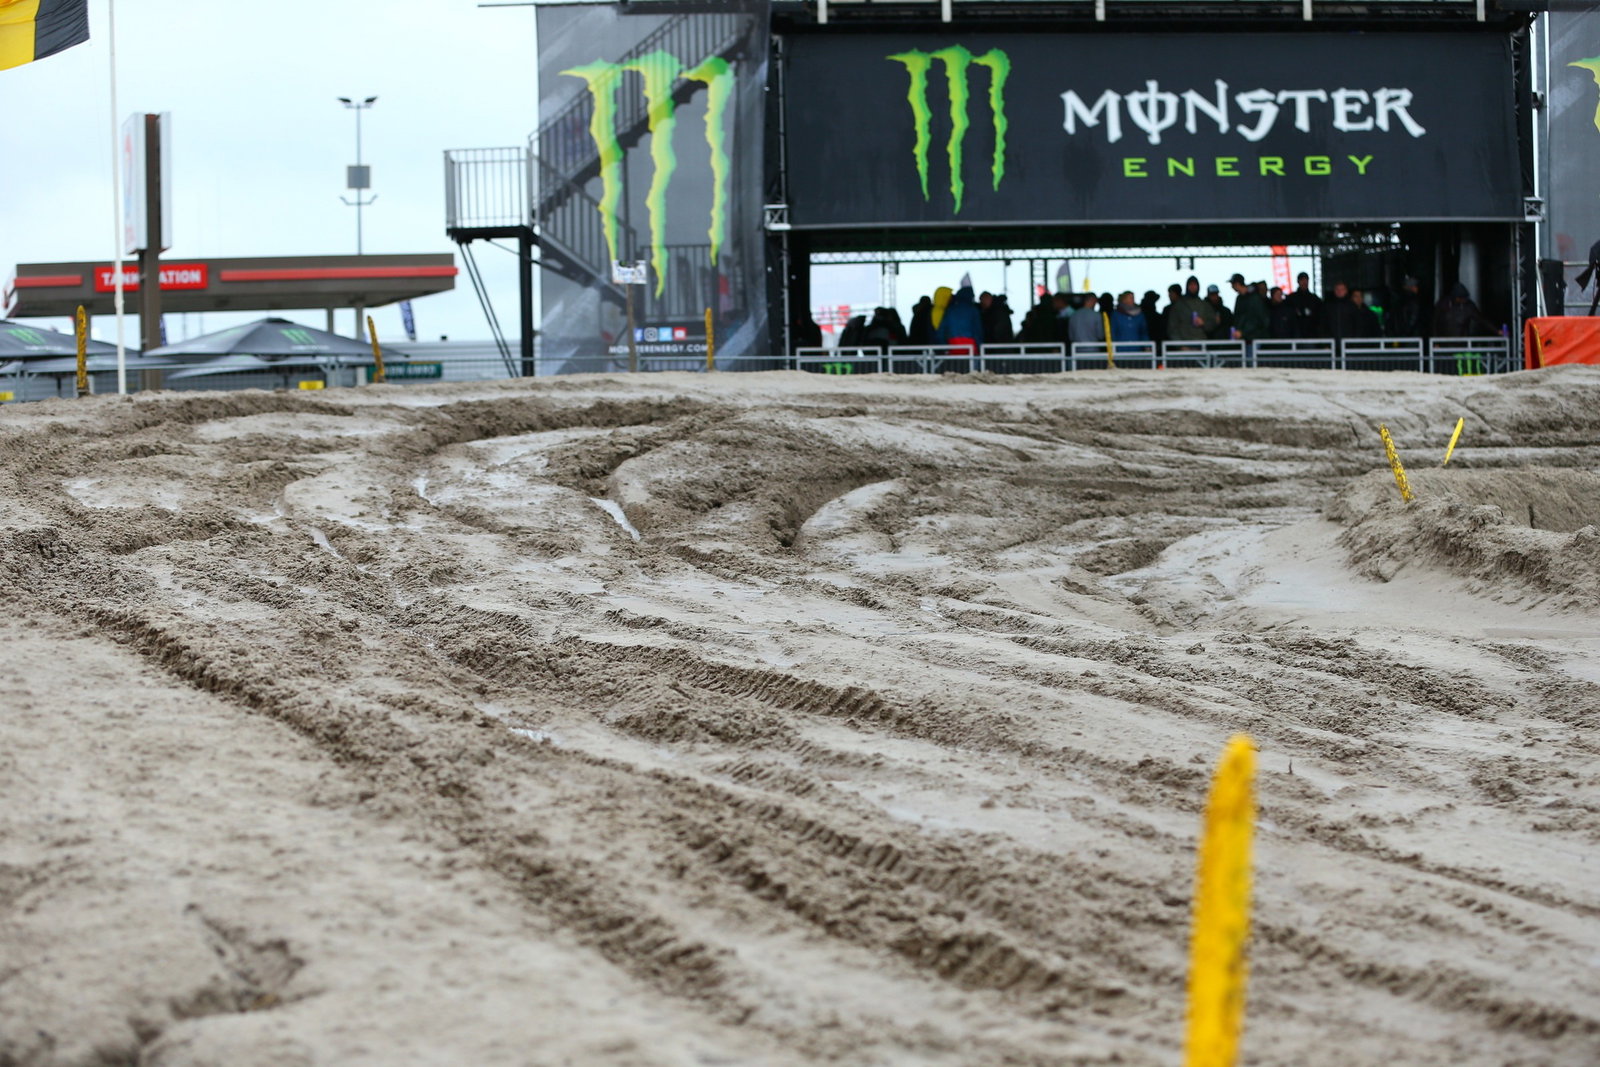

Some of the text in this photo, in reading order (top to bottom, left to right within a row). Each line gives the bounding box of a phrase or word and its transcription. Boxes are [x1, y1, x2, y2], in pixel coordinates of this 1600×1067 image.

[1060, 78, 1426, 146] MONSTER
[1123, 154, 1374, 178] ENERGY
[101, 269, 202, 286] TANKATION
[608, 343, 712, 354] MONTERENERGY.COM
